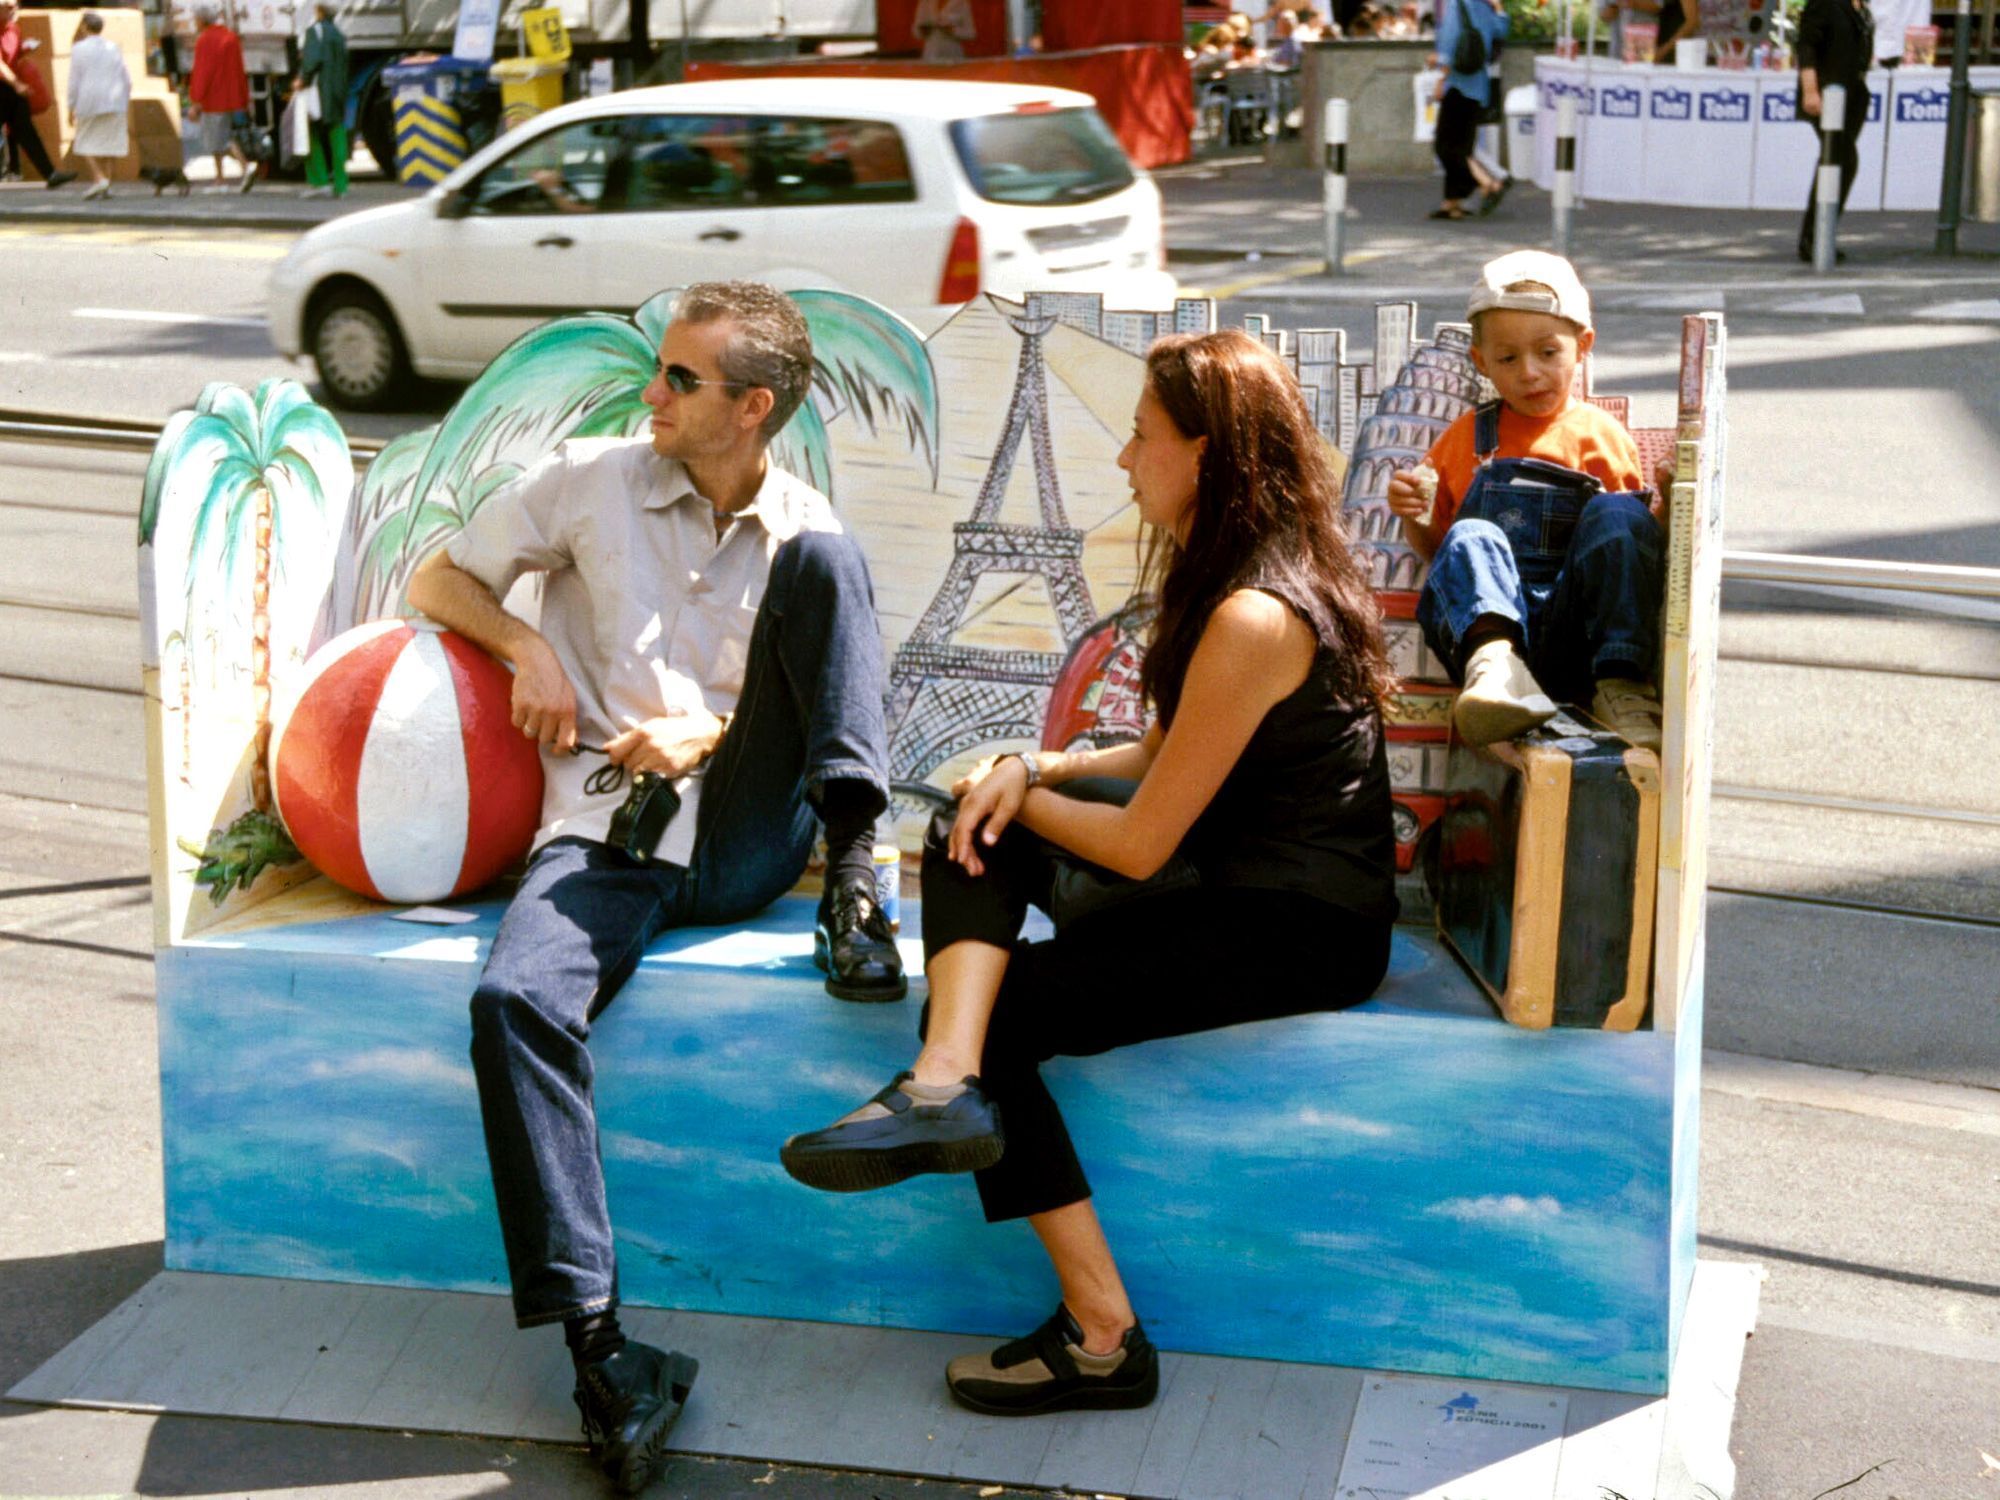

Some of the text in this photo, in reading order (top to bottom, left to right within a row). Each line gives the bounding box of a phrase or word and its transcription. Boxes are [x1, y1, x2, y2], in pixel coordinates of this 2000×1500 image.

[1655, 95, 1689, 118] Toni
[1703, 96, 1745, 119] Toni
[1902, 97, 1948, 120] Toni
